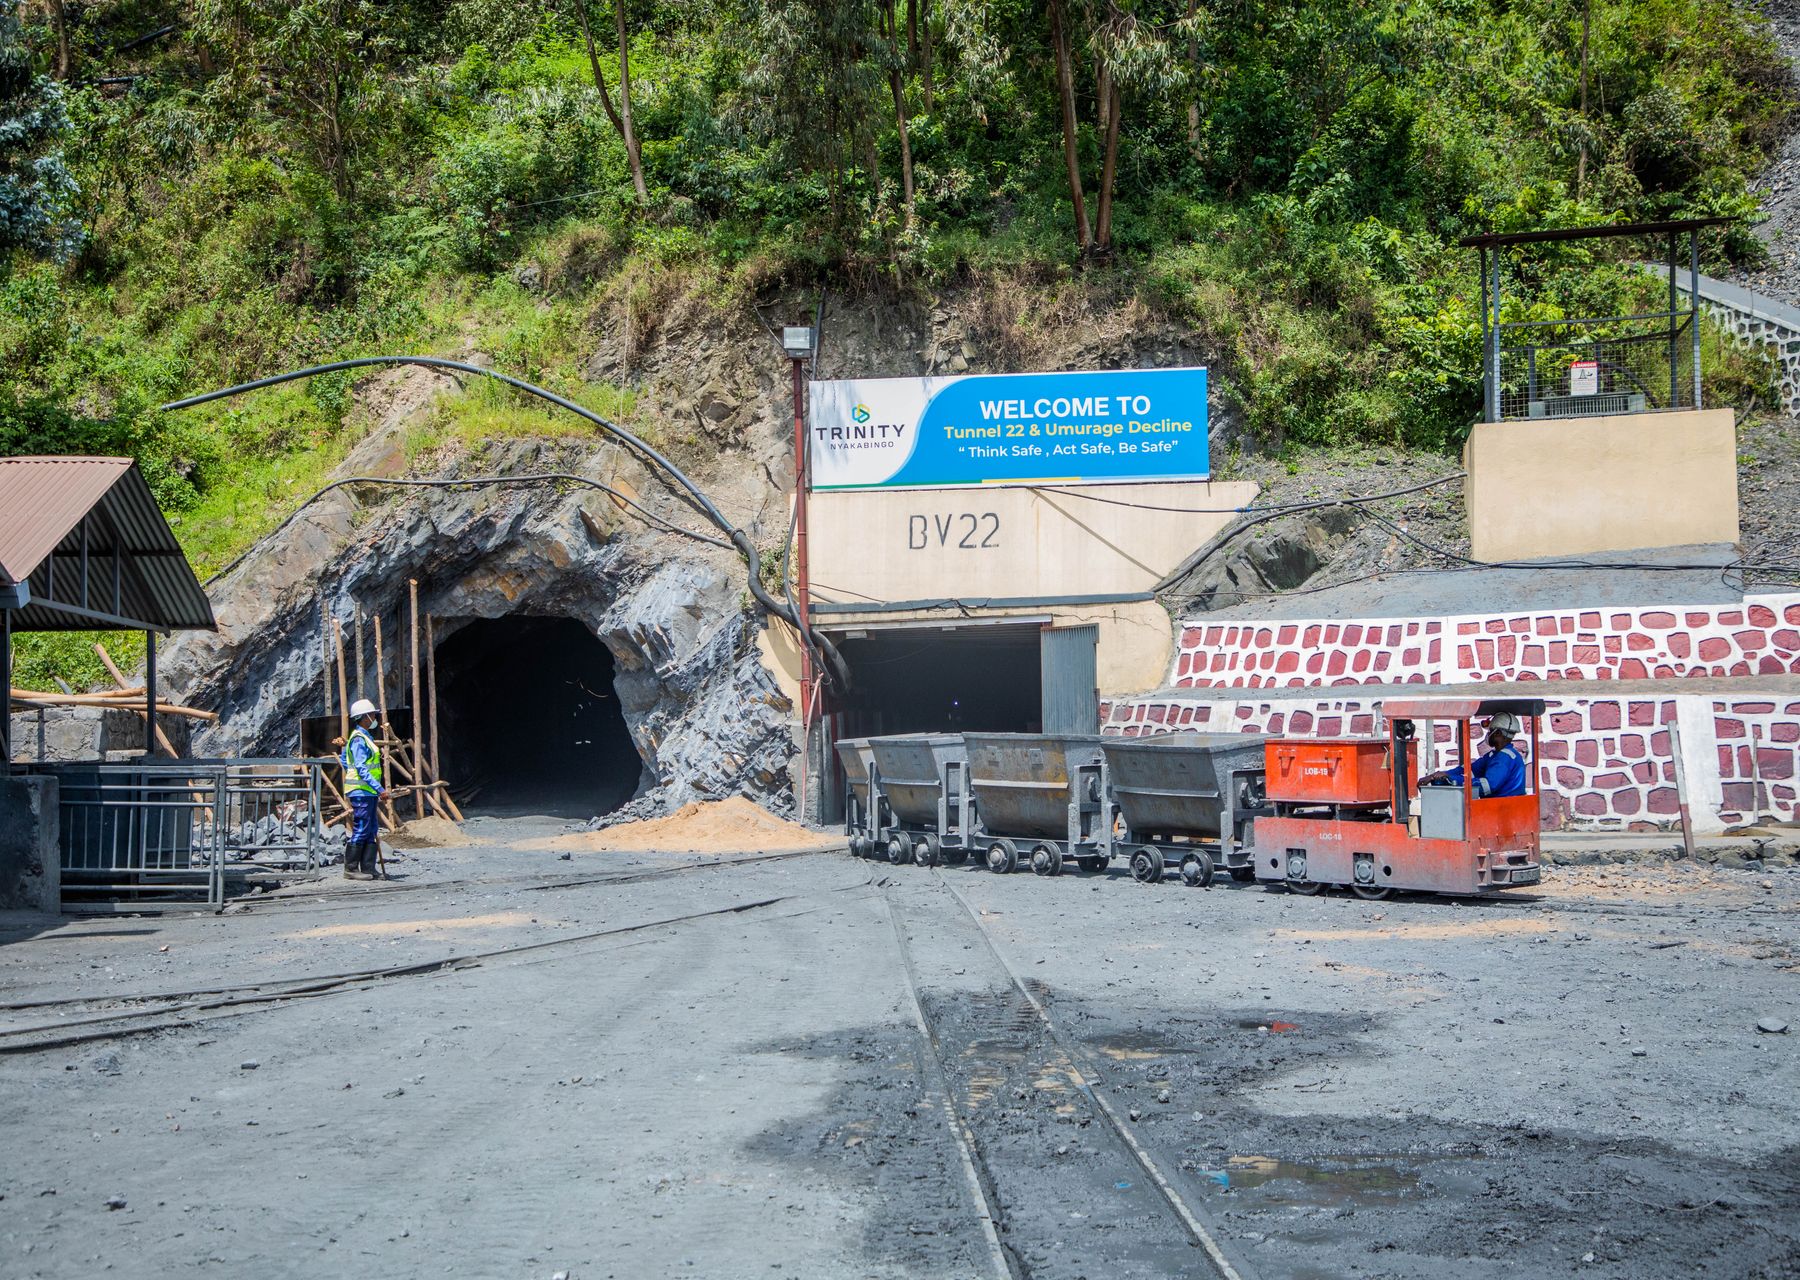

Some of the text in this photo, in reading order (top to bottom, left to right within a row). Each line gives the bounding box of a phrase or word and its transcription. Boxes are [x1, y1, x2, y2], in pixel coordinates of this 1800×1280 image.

[980, 395, 1151, 420] WELCOME TO
[815, 424, 905, 441] TRINITY
[944, 418, 1193, 439] Tunnel 22 & Umurage Decline
[830, 441, 895, 450] NYAKABINGO
[968, 445, 1008, 458] Think
[1011, 444, 1043, 457] Safe
[1052, 444, 1078, 455] Act
[1080, 441, 1115, 456] Safe,
[1118, 442, 1138, 454] Be
